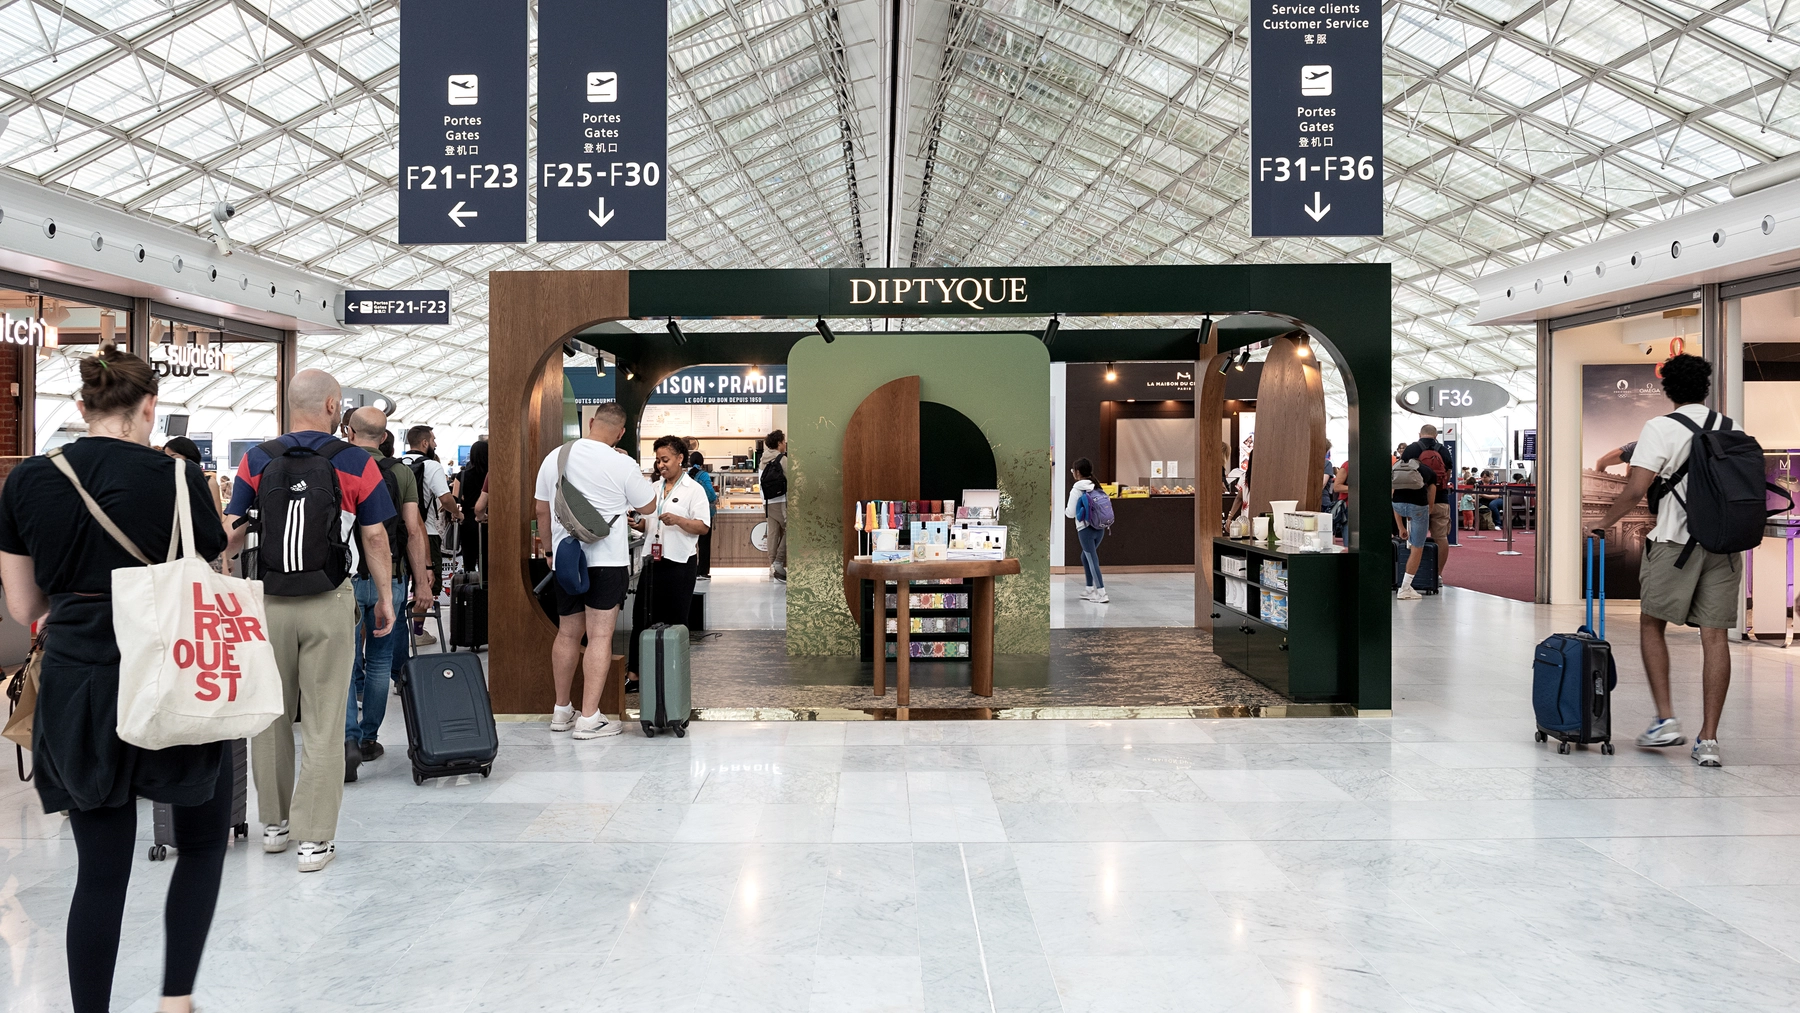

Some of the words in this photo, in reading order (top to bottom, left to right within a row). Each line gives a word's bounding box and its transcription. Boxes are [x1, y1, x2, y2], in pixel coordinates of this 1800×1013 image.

[1272, 4, 1315, 14] Service
[1319, 3, 1360, 14] clients
[1263, 19, 1322, 30] Customer
[1325, 18, 1369, 29] Service
[1304, 33, 1327, 45] 客服
[1297, 106, 1336, 117] Portes
[443, 115, 482, 127] Portes
[582, 113, 621, 124] Portes
[1299, 121, 1334, 132] Gates
[445, 130, 480, 141] Gates
[584, 128, 619, 138] Gates
[1298, 136, 1333, 148] 登机口
[444, 145, 479, 156] 登机口
[583, 143, 618, 154] 登机口
[543, 162, 660, 188] F25-F30
[1260, 156, 1375, 182] F31-F36
[407, 164, 518, 190] F21-F23
[849, 277, 1028, 310] DIPTYQUE
[388, 300, 447, 314] F21-F23
[0, 312, 44, 346] tch
[168, 343, 225, 371] swatch
[718, 375, 786, 394] PRADIE
[1438, 389, 1473, 407] F36
